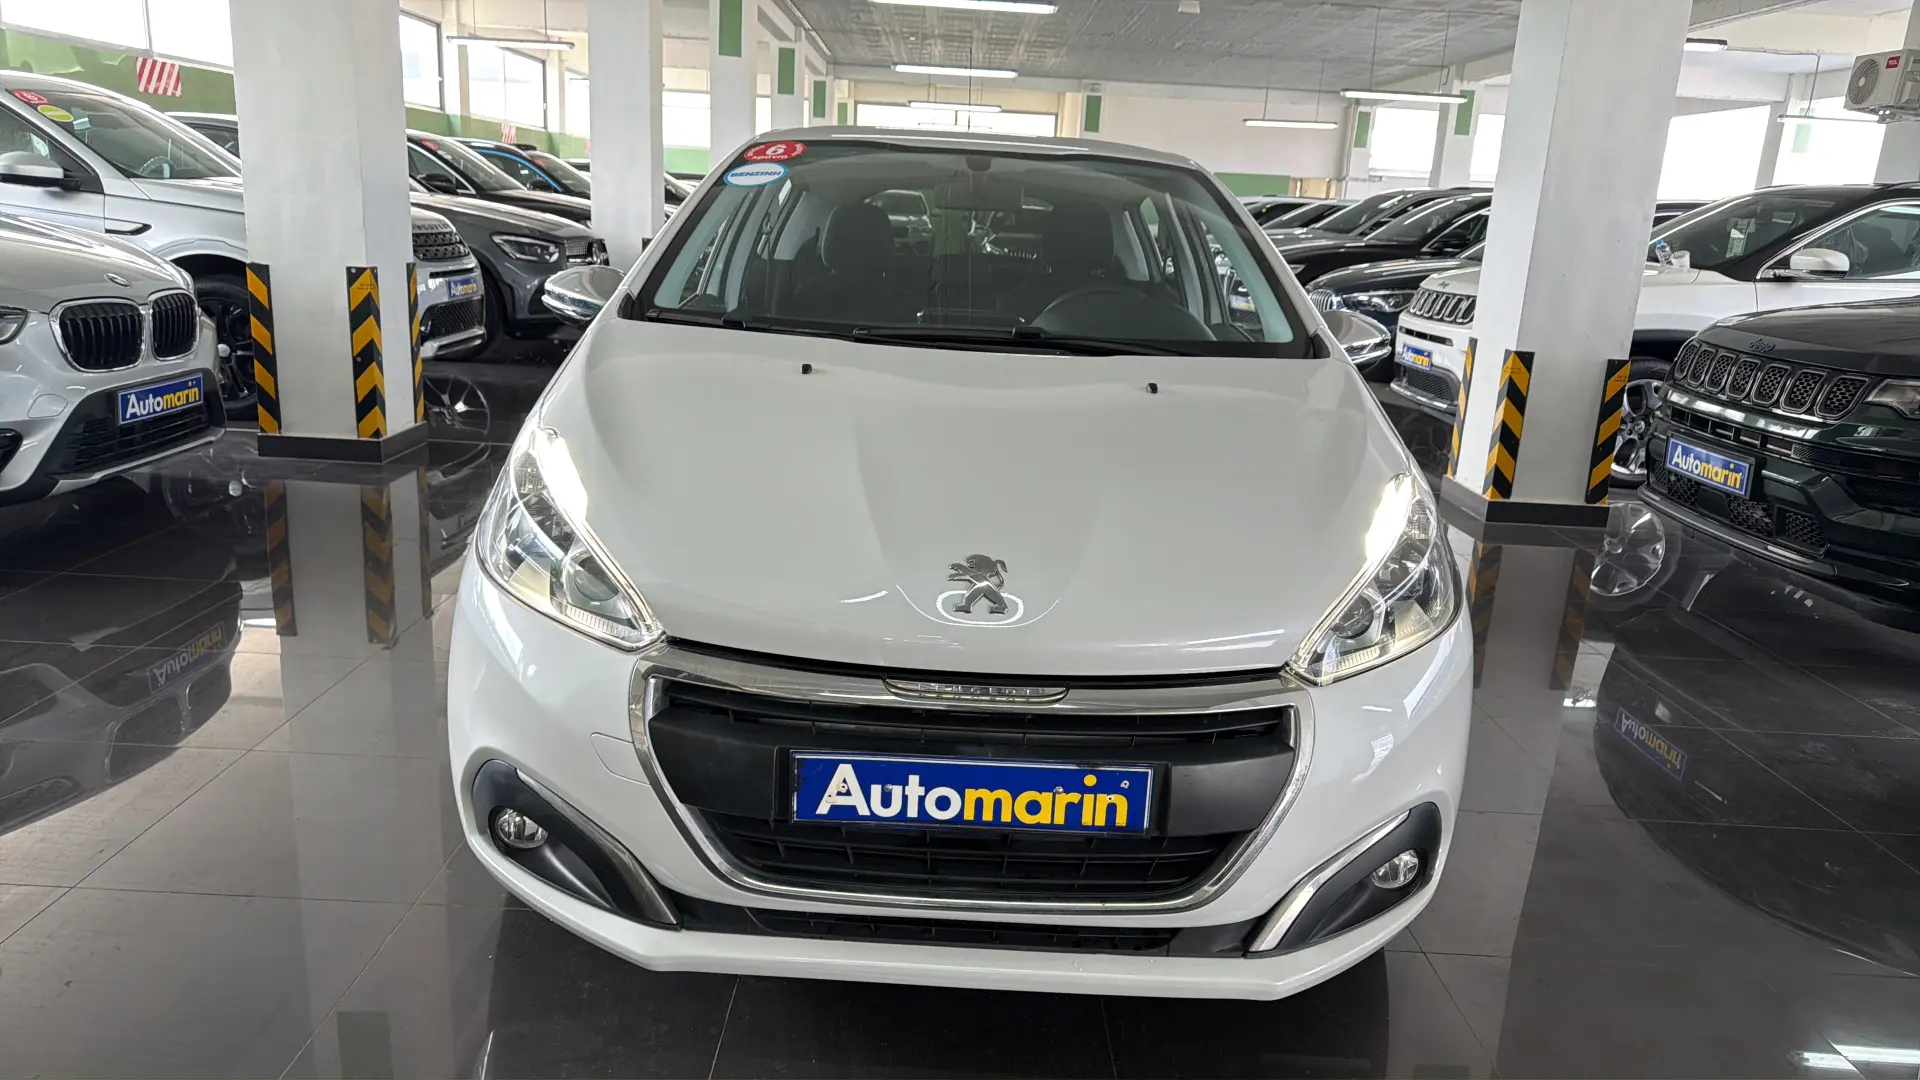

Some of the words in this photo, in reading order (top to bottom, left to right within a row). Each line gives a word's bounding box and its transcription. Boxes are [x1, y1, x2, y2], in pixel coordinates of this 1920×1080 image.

[765, 144, 787, 156] 6
[126, 380, 199, 419] Automarin
[1671, 445, 1742, 489] Automarin
[815, 763, 1128, 827] Automarin
